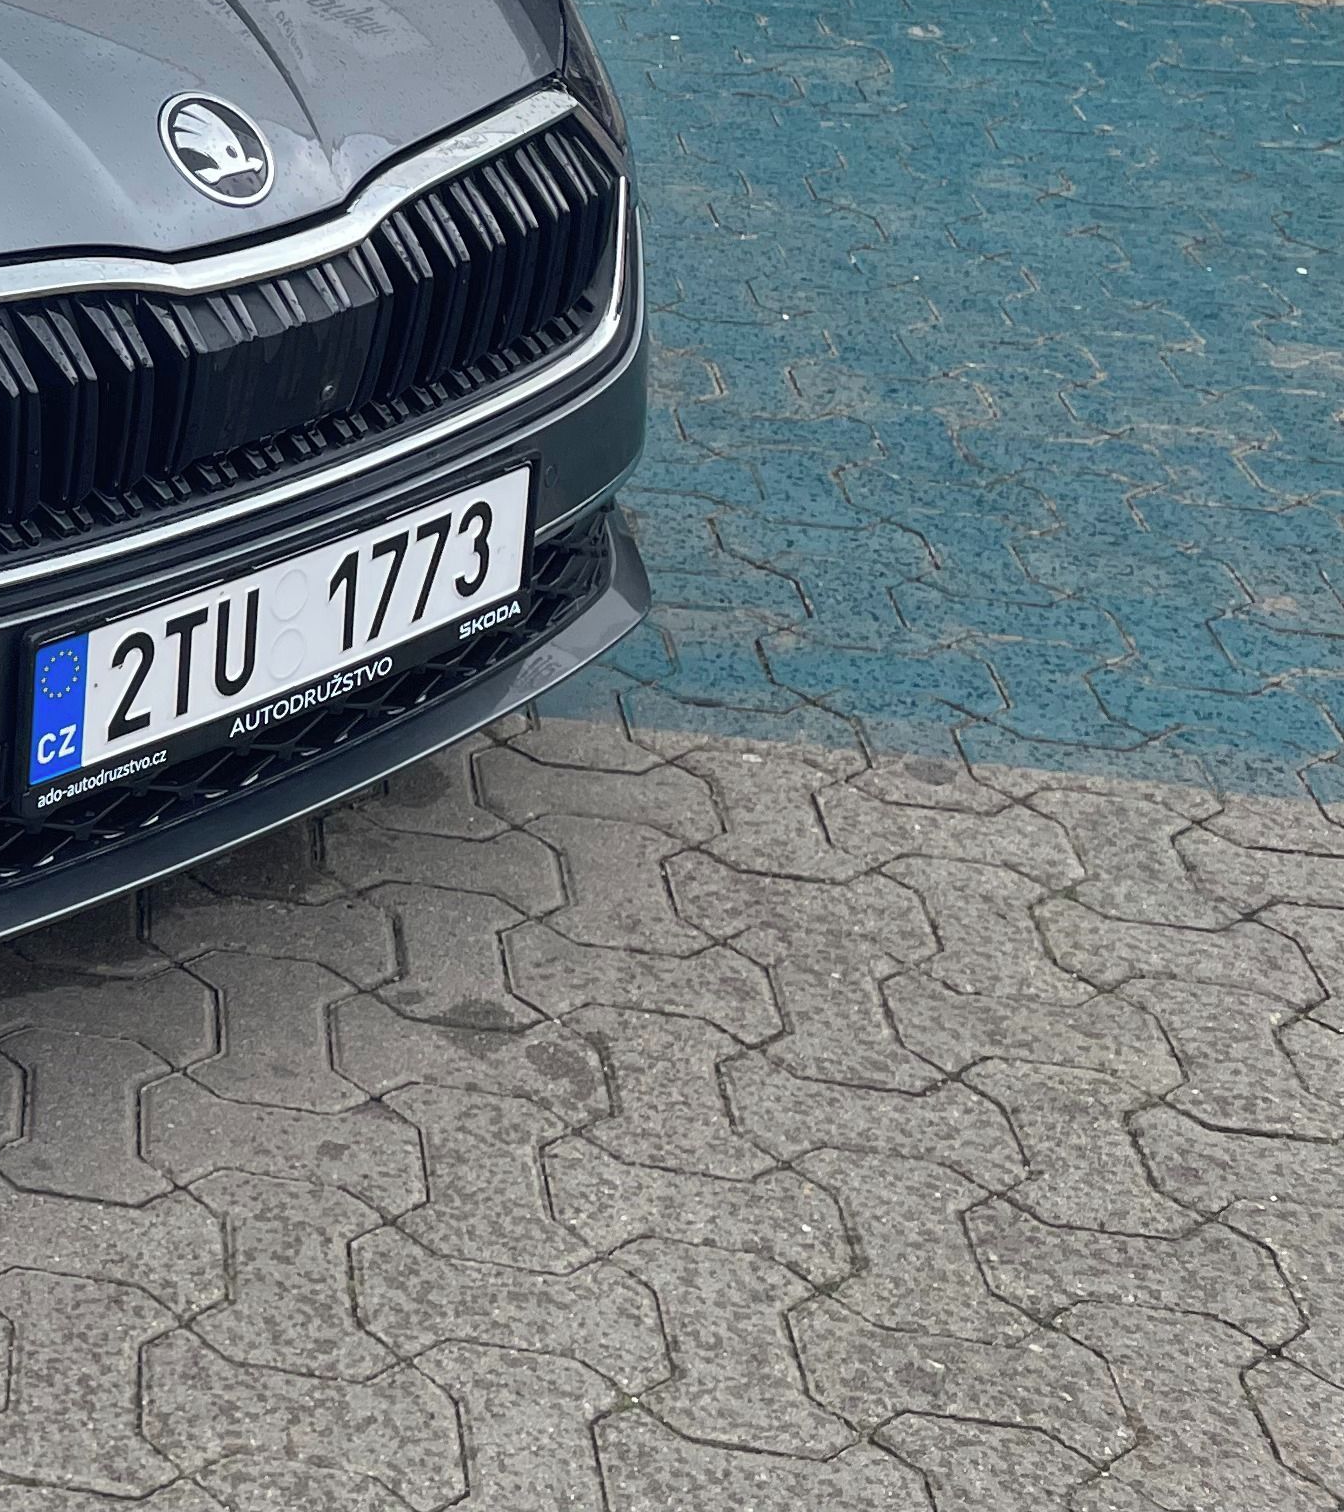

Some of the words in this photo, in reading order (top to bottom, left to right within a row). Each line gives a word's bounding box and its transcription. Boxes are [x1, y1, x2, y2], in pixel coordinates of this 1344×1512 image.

[106, 589, 260, 743] 2TU
[327, 500, 494, 653] 1773
[228, 656, 393, 739] AUTODRUŽSTVO
[37, 724, 77, 764] CZ
[37, 749, 167, 809] ado-autodruzstvo.cz
